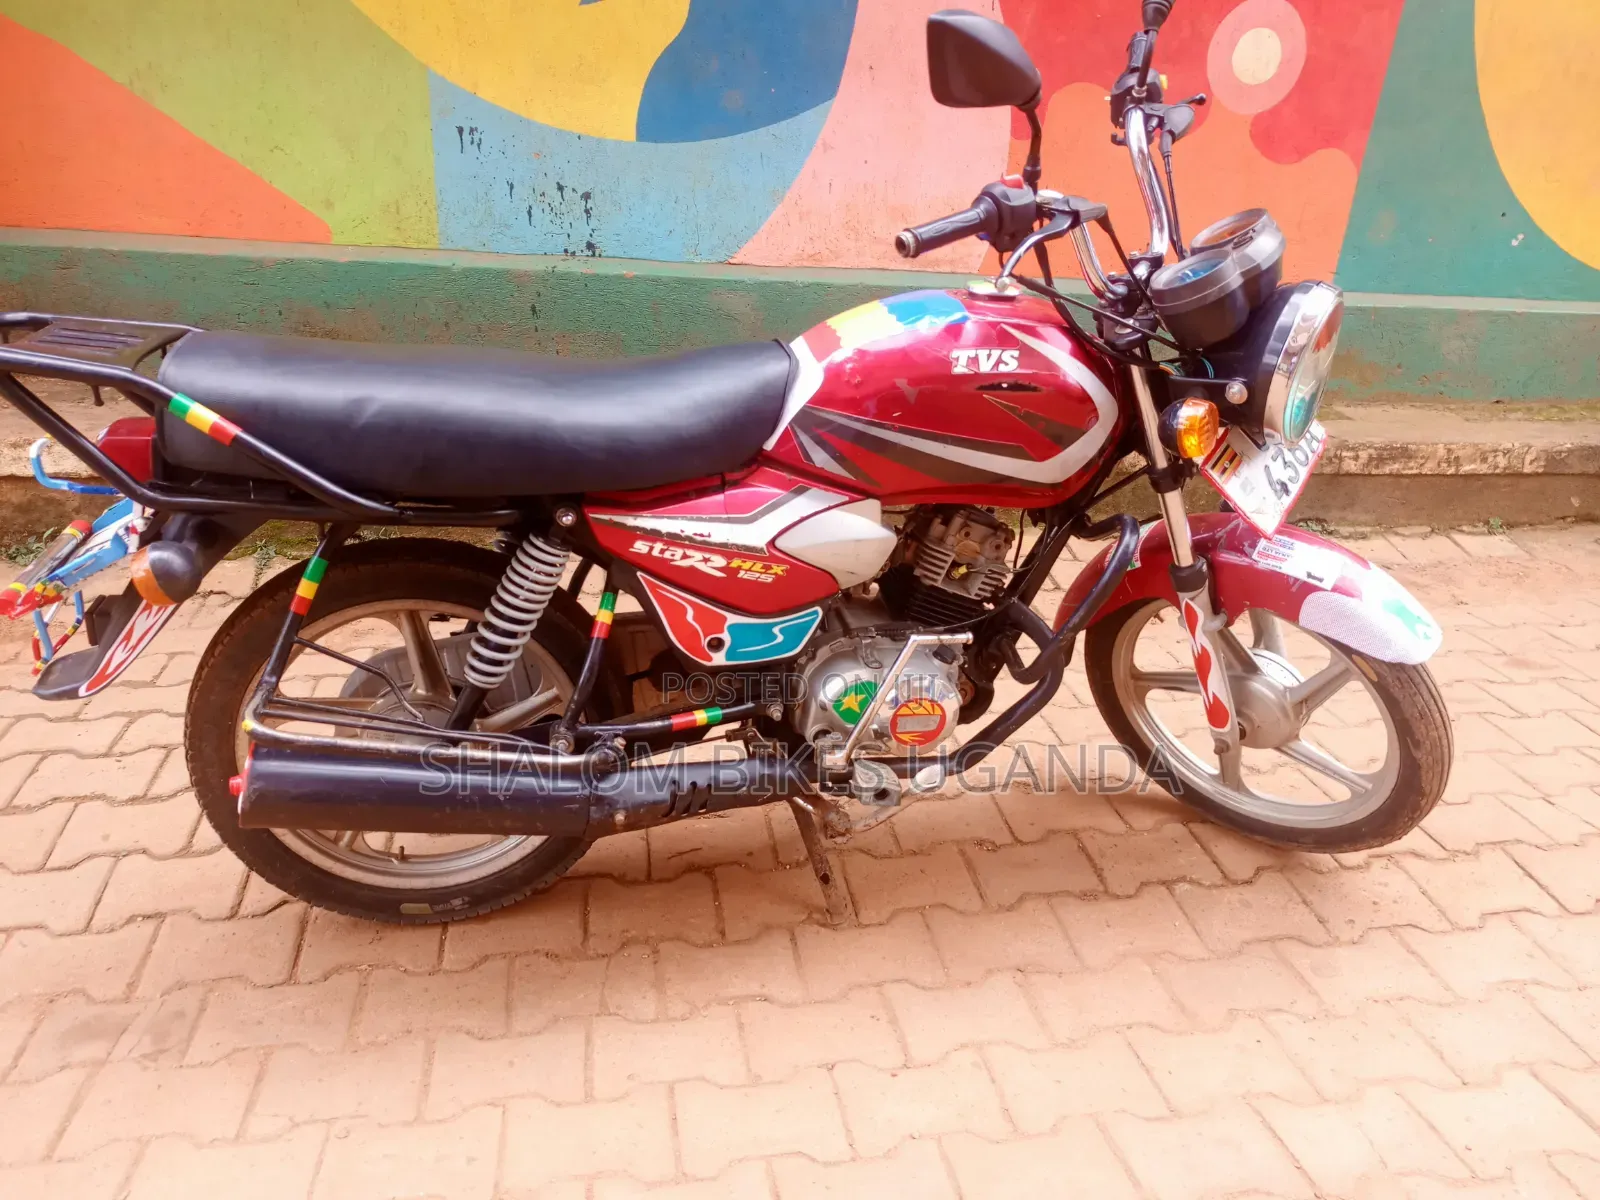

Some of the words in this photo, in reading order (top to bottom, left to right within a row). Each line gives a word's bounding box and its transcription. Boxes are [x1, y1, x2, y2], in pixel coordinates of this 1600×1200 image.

[951, 349, 1020, 374] TVS
[729, 557, 788, 576] HLX
[736, 569, 776, 584] 125
